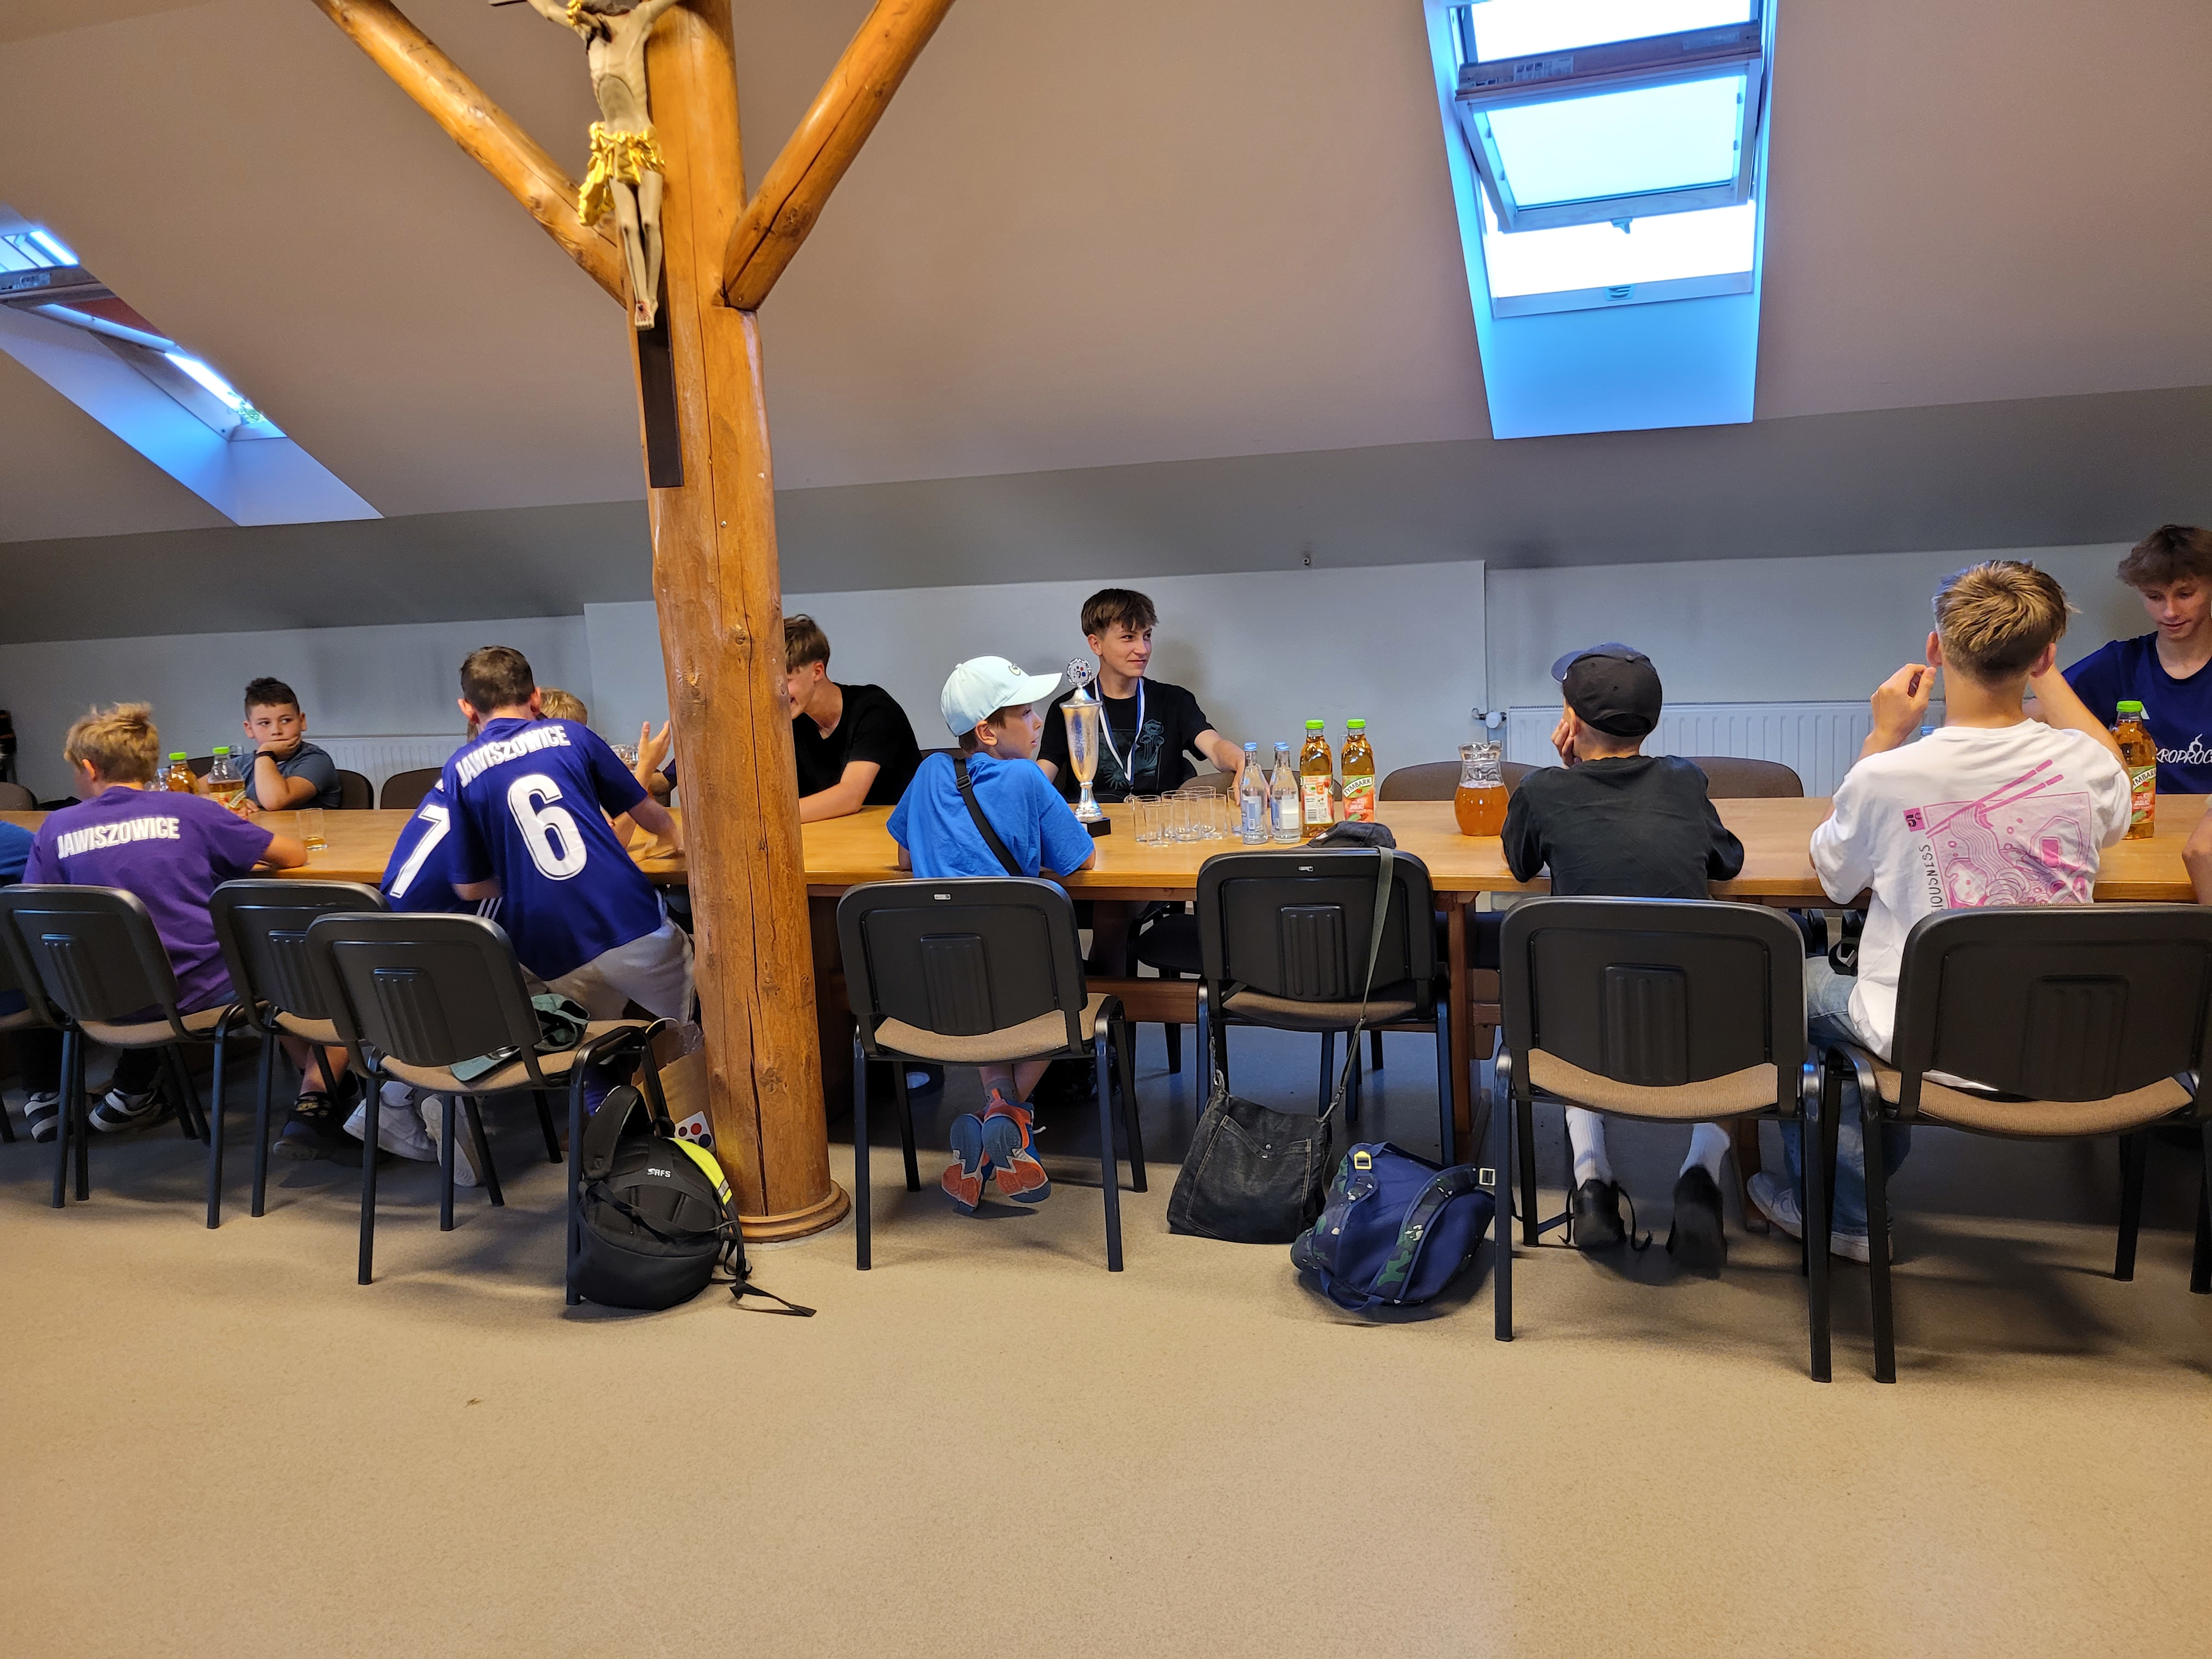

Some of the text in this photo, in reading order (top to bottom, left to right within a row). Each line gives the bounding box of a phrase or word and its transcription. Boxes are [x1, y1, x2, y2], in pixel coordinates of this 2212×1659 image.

[454, 725, 571, 789] JAWISZOWICE
[1343, 778, 1371, 796] TYMBARK
[58, 817, 180, 859] JAWISZOWICE
[389, 804, 451, 899] 7
[507, 774, 588, 881] 6
[1919, 844, 1943, 914] IOUSNESS
